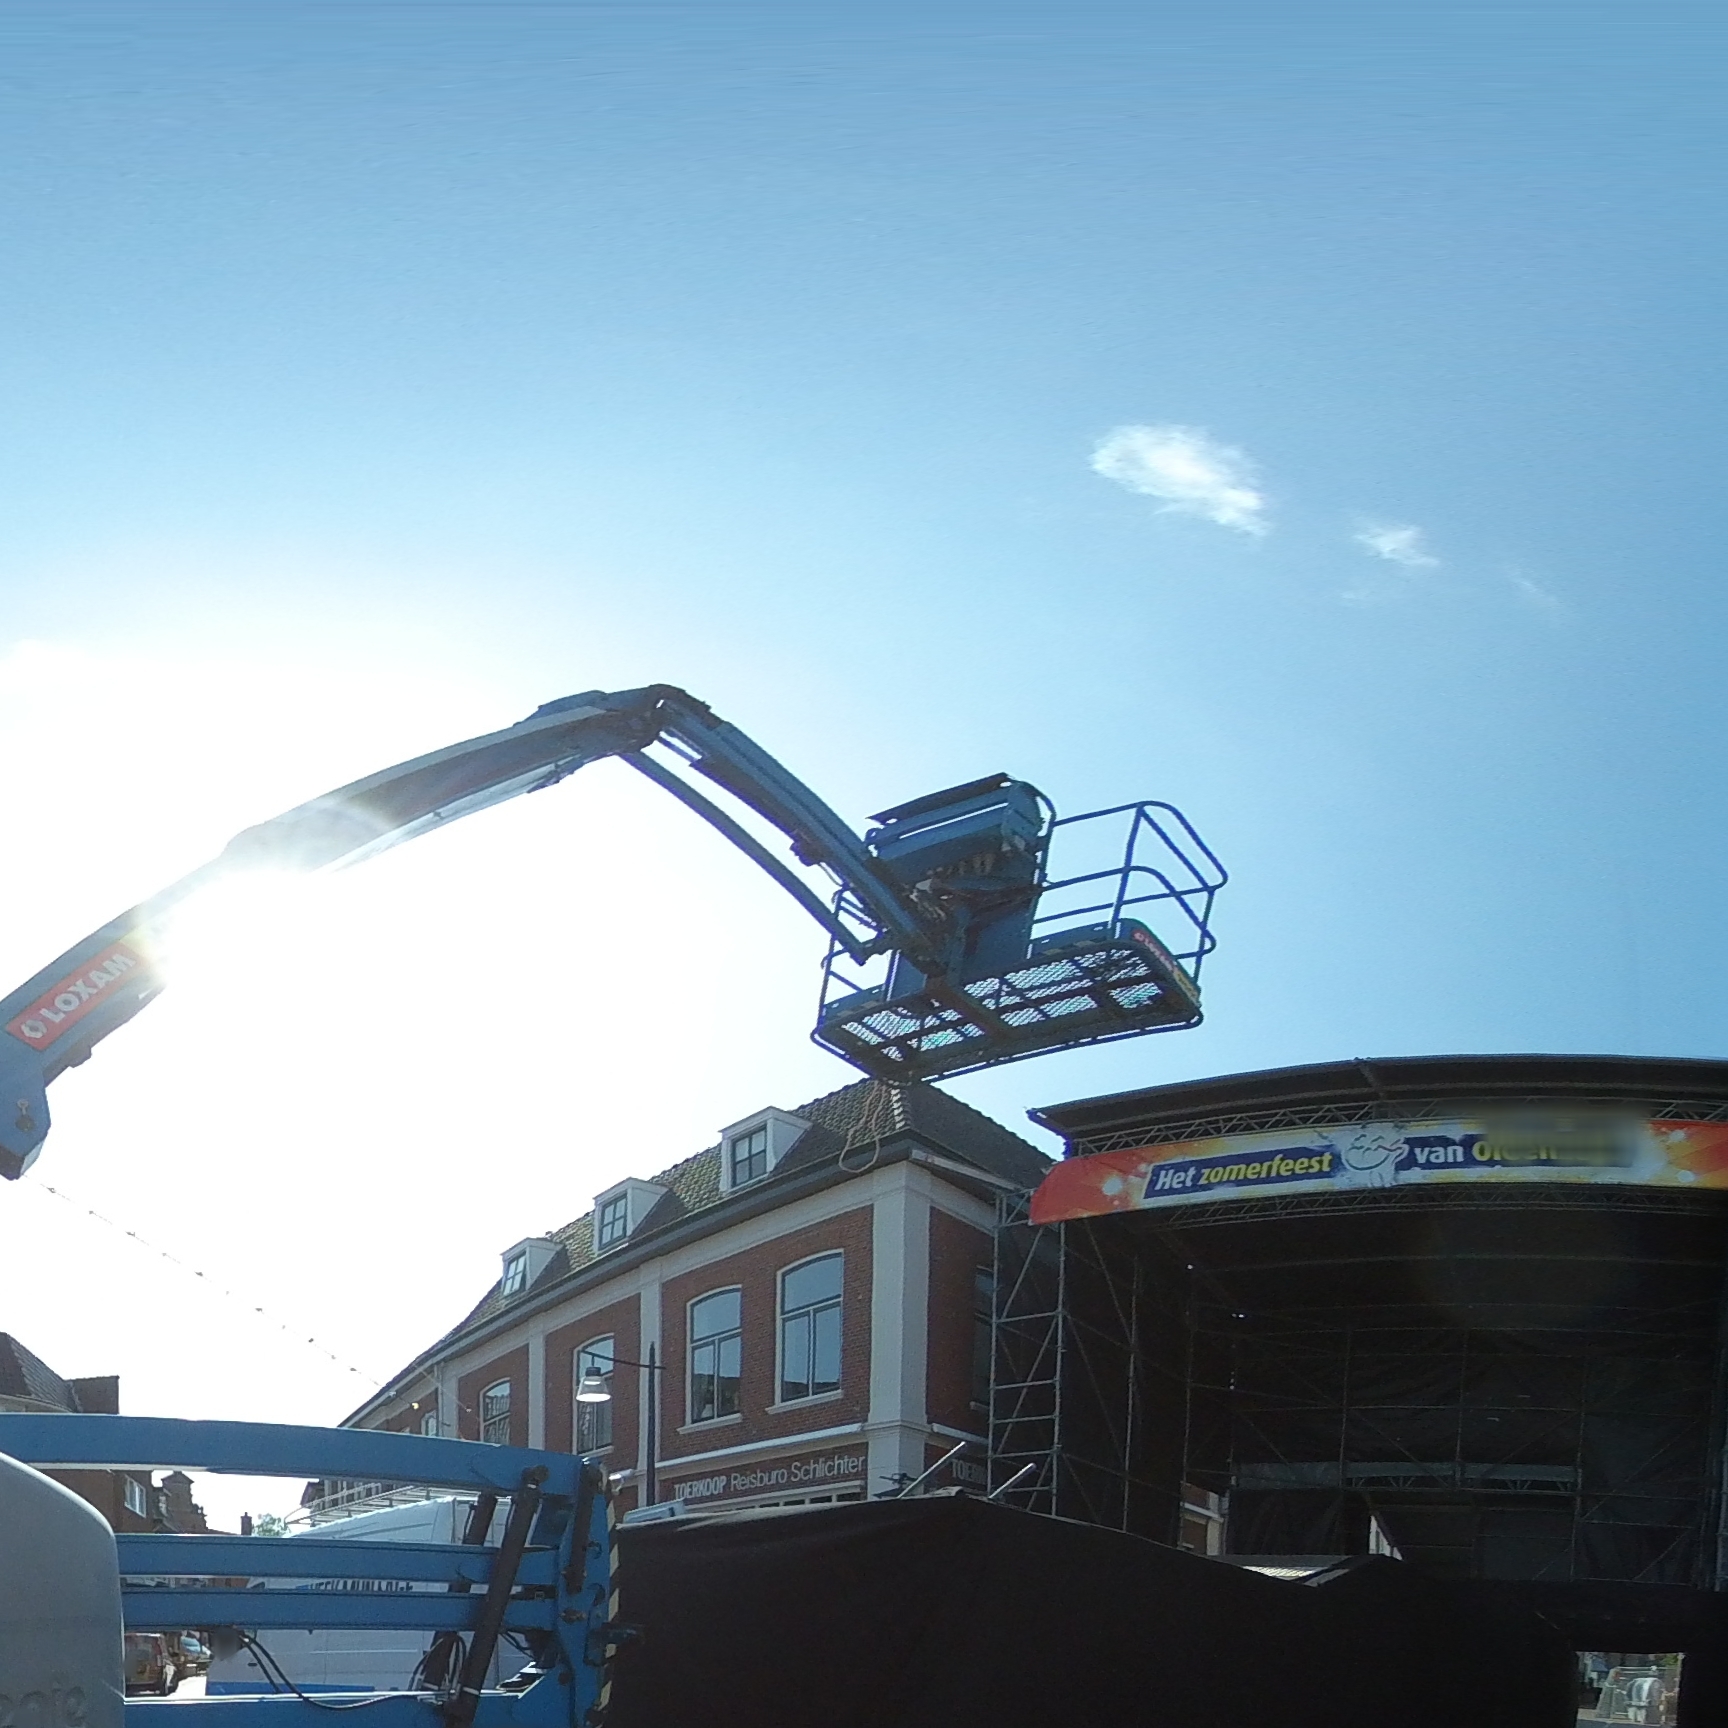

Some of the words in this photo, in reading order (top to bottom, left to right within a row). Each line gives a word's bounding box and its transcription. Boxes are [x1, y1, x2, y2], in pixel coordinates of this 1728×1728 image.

[39, 953, 138, 1024] LOXAM
[1153, 1168, 1196, 1191] Het
[1198, 1151, 1333, 1185] zomerfeest
[1413, 1144, 1464, 1165] van
[673, 1475, 727, 1500] TOERKOOP
[730, 1468, 788, 1492] Reisburo
[790, 1454, 866, 1482] Schlichter
